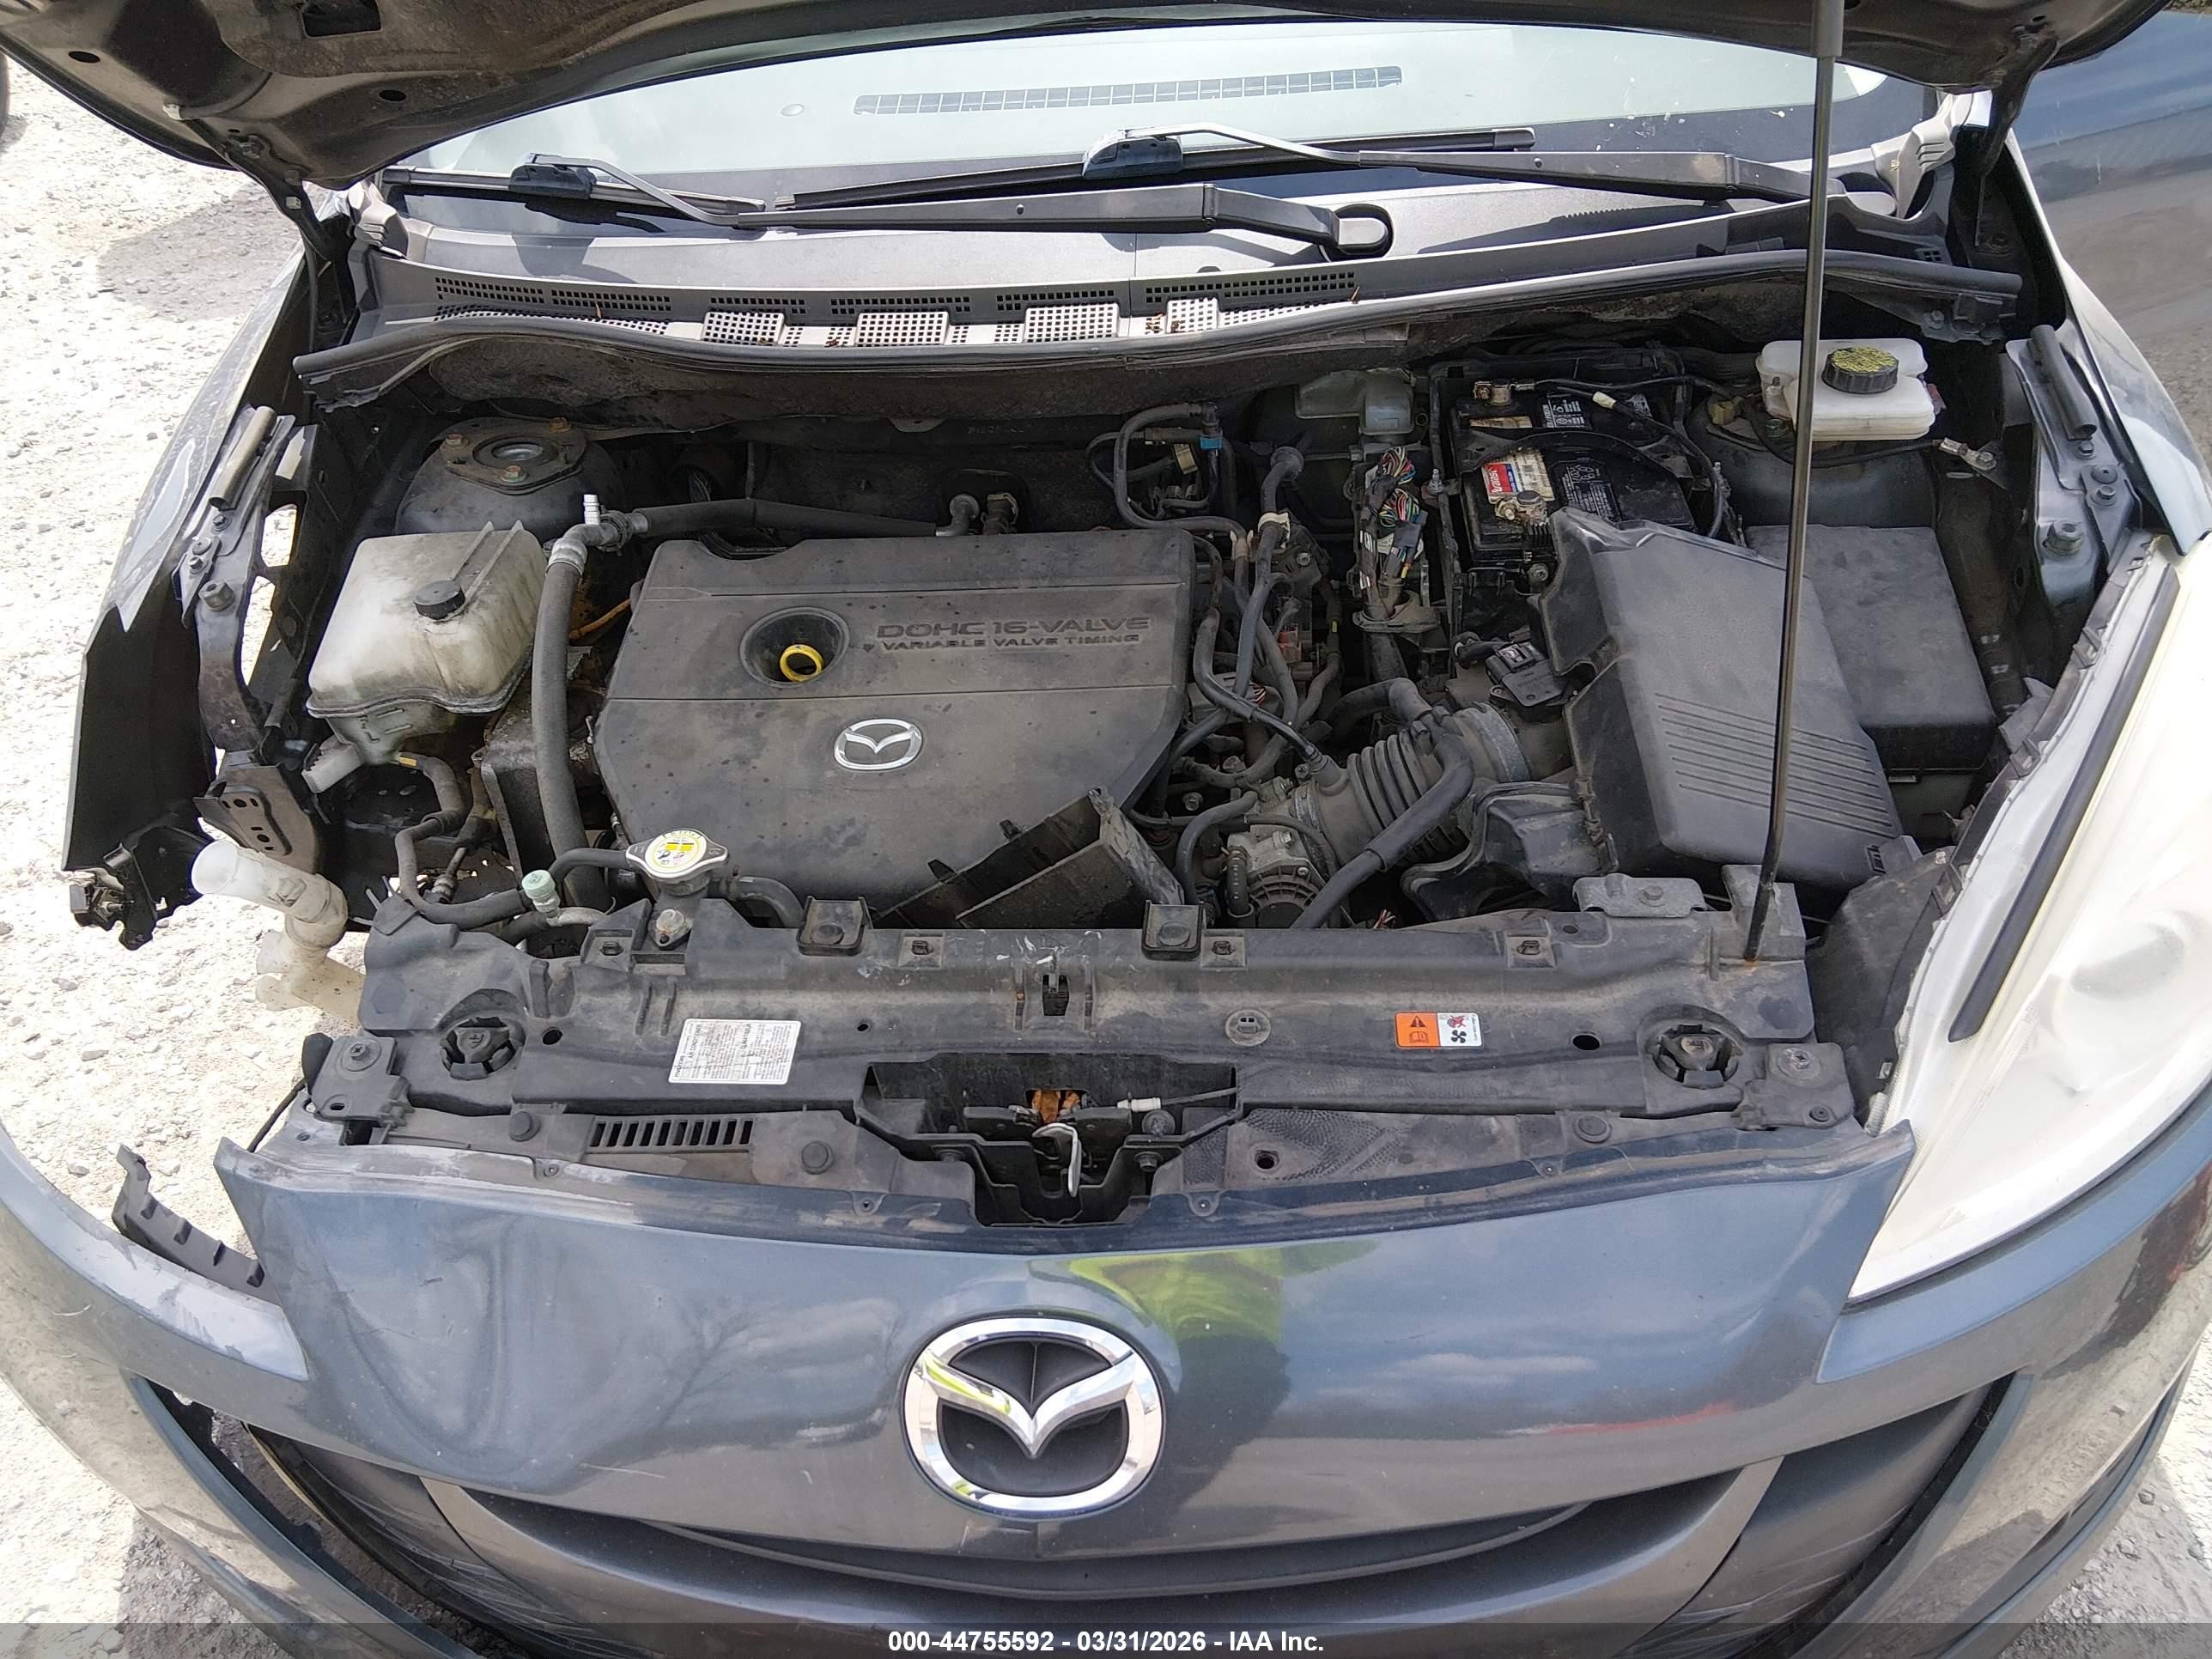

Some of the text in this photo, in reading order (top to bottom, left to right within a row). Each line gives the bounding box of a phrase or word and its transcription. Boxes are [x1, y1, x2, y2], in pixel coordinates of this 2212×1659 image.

[877, 617, 1151, 638] DOHC 16-VALVE
[881, 634, 1140, 651] VARIABLE VALVE TIMING
